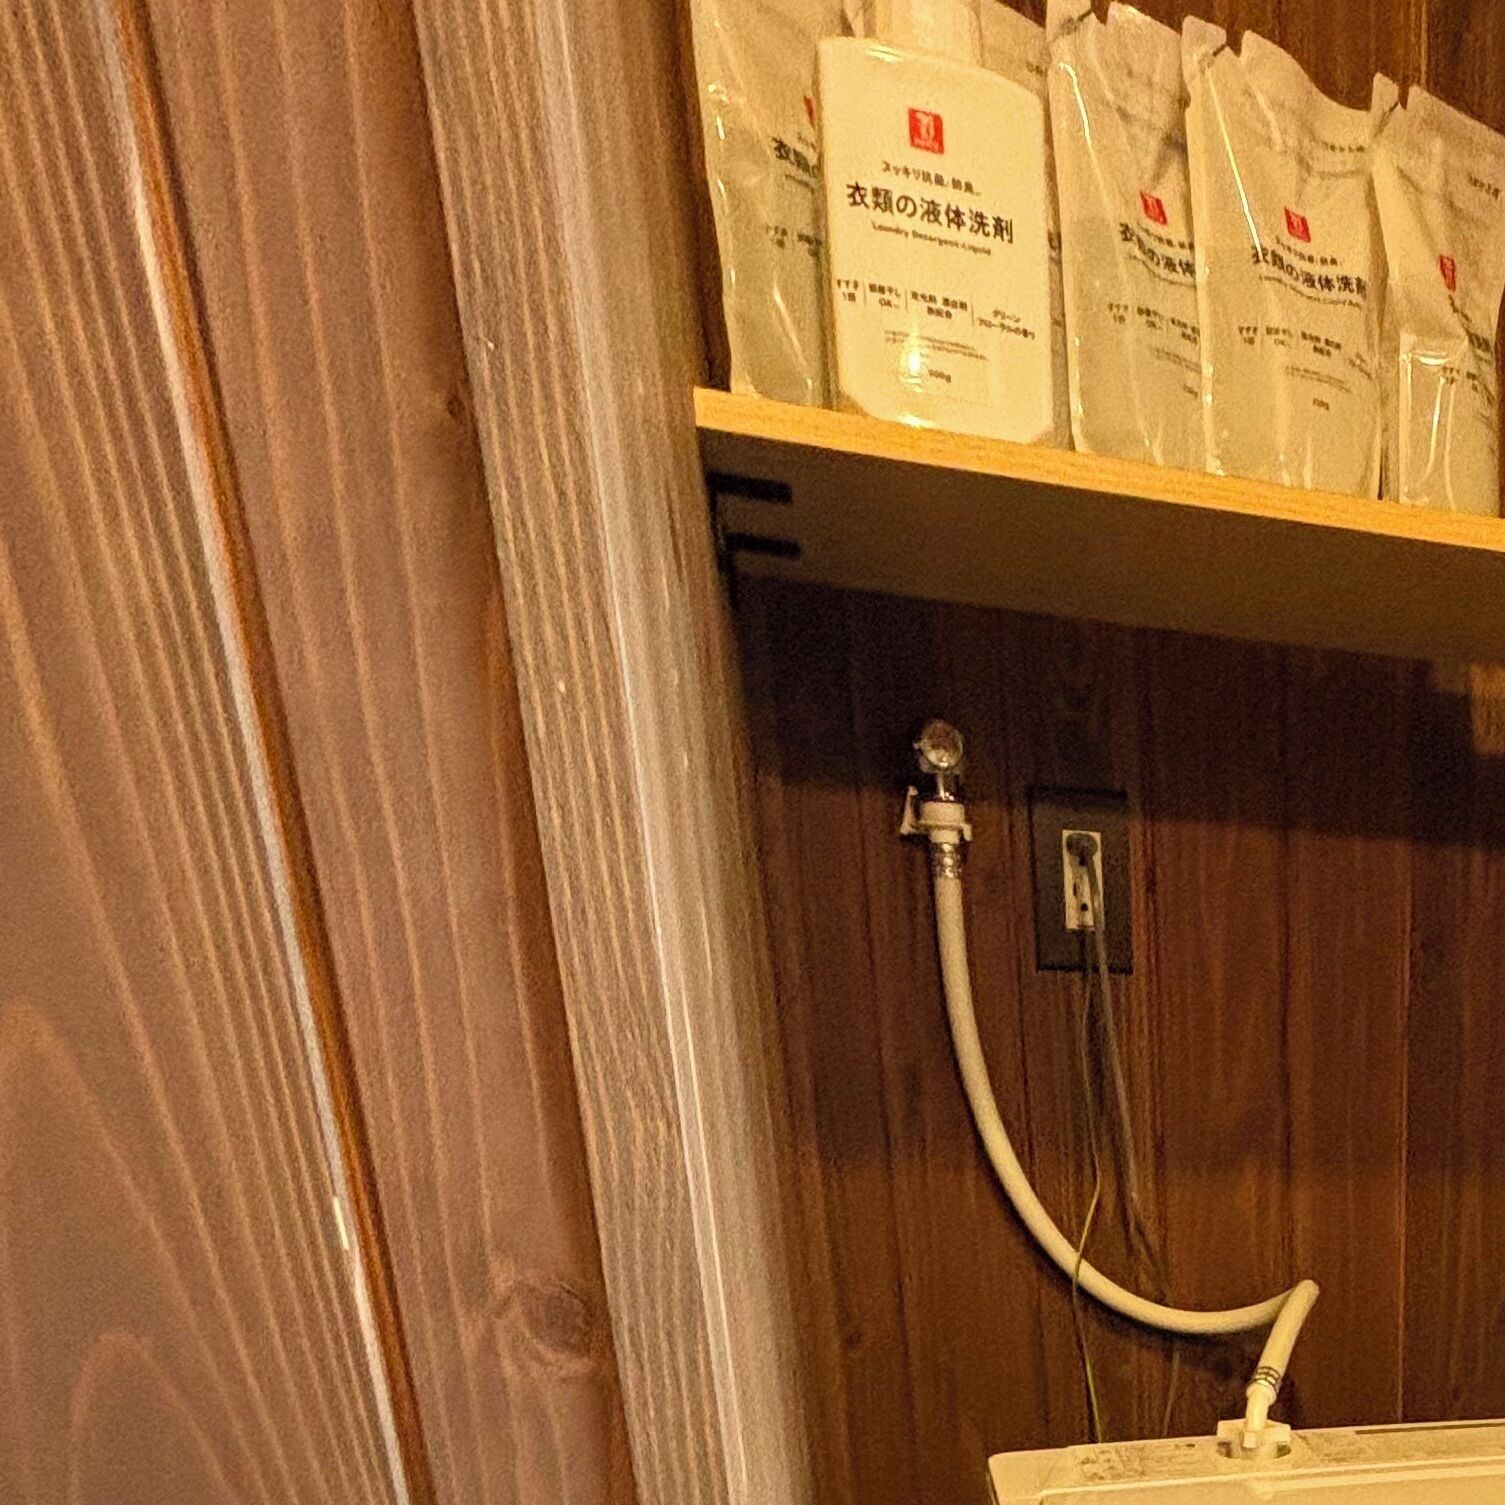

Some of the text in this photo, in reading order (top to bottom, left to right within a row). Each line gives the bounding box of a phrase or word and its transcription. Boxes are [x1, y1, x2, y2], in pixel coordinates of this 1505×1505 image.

[846, 181, 1014, 244] 衣類の液体洗剤
